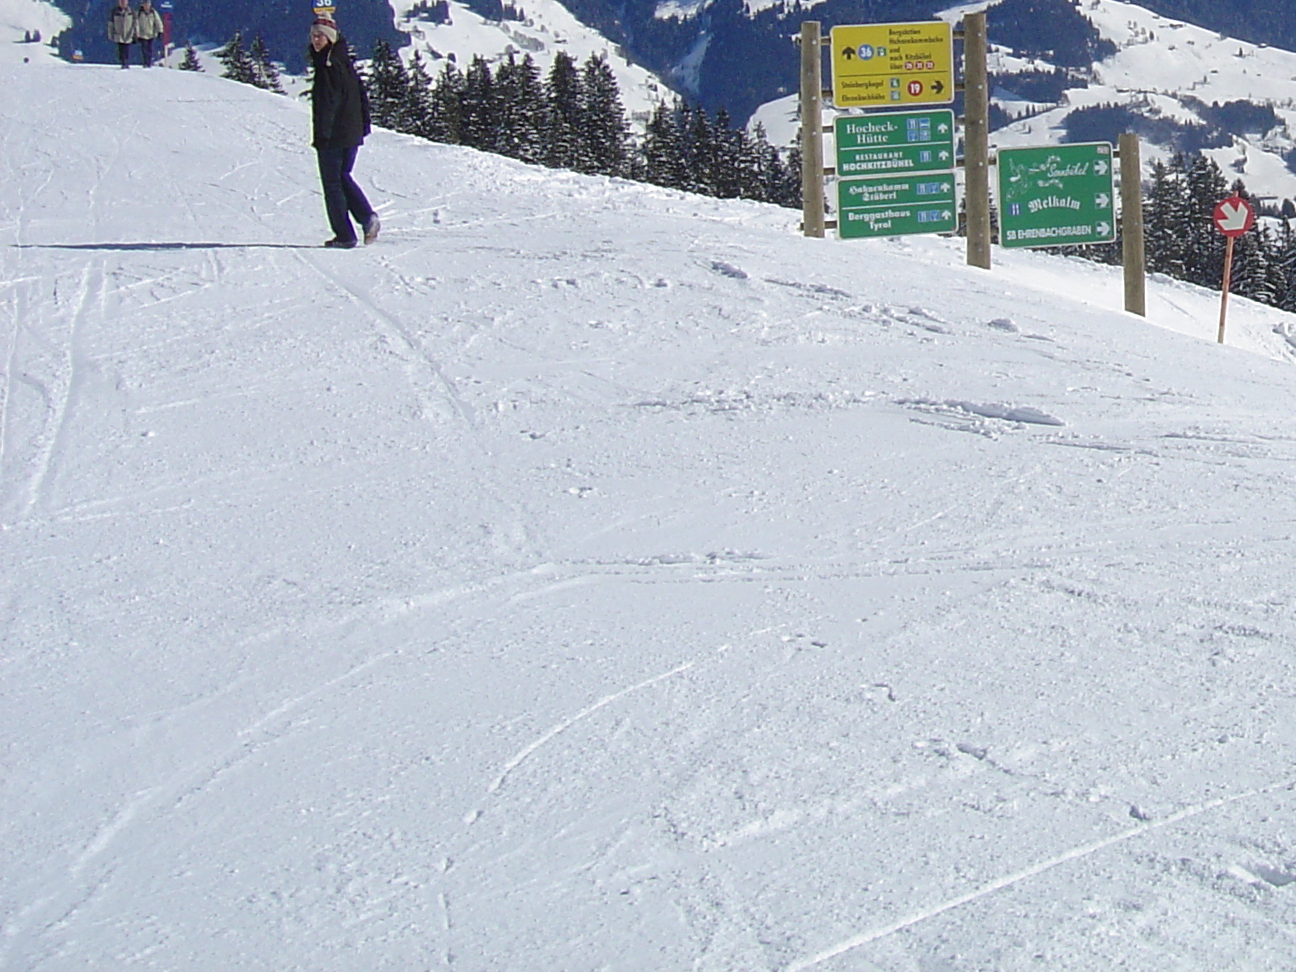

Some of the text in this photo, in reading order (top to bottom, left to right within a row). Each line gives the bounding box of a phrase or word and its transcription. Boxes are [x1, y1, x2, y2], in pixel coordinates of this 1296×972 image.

[860, 47, 872, 58] 36
[910, 83, 920, 94] 19
[846, 121, 898, 134] Hocheck-
[857, 134, 888, 144] Hütte
[855, 152, 903, 161] RESTAURANT
[842, 159, 914, 171] HOCHKITZBÜHEL
[1027, 195, 1081, 213] Melkalm
[848, 209, 911, 222] Berggasthaus
[869, 220, 891, 231] Tyrol
[1006, 225, 1092, 240] SB EHRENBACHGRABEN
